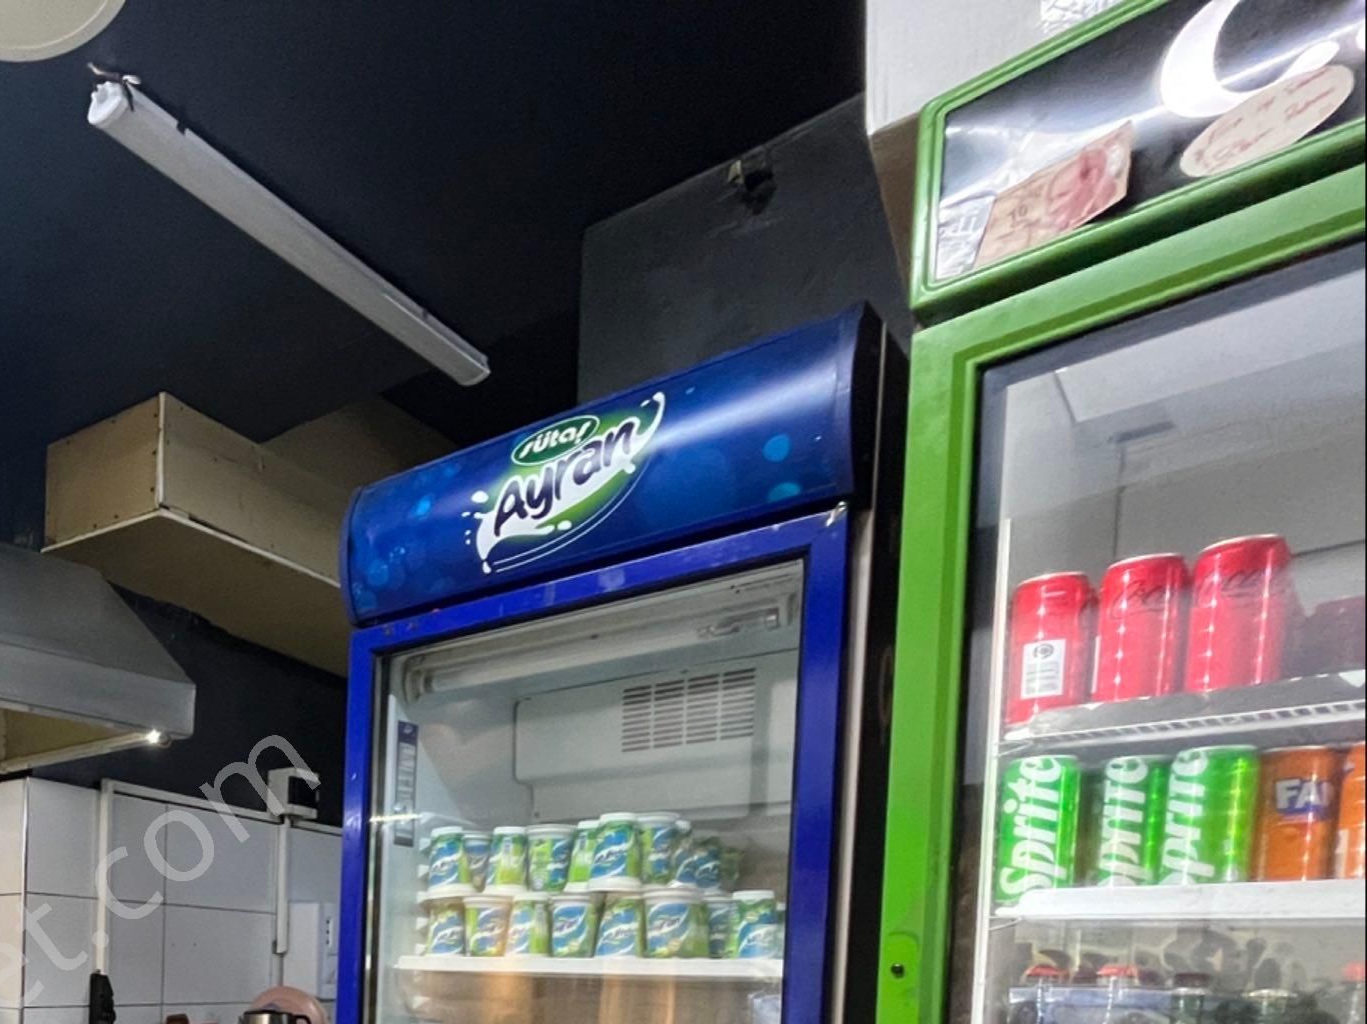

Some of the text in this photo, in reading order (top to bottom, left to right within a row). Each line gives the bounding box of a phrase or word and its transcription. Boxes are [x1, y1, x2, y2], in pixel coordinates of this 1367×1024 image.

[494, 421, 635, 537] Ayran
[1000, 757, 1067, 894] Sprite
[1096, 757, 1155, 887] prite
[1162, 750, 1215, 885] prite
